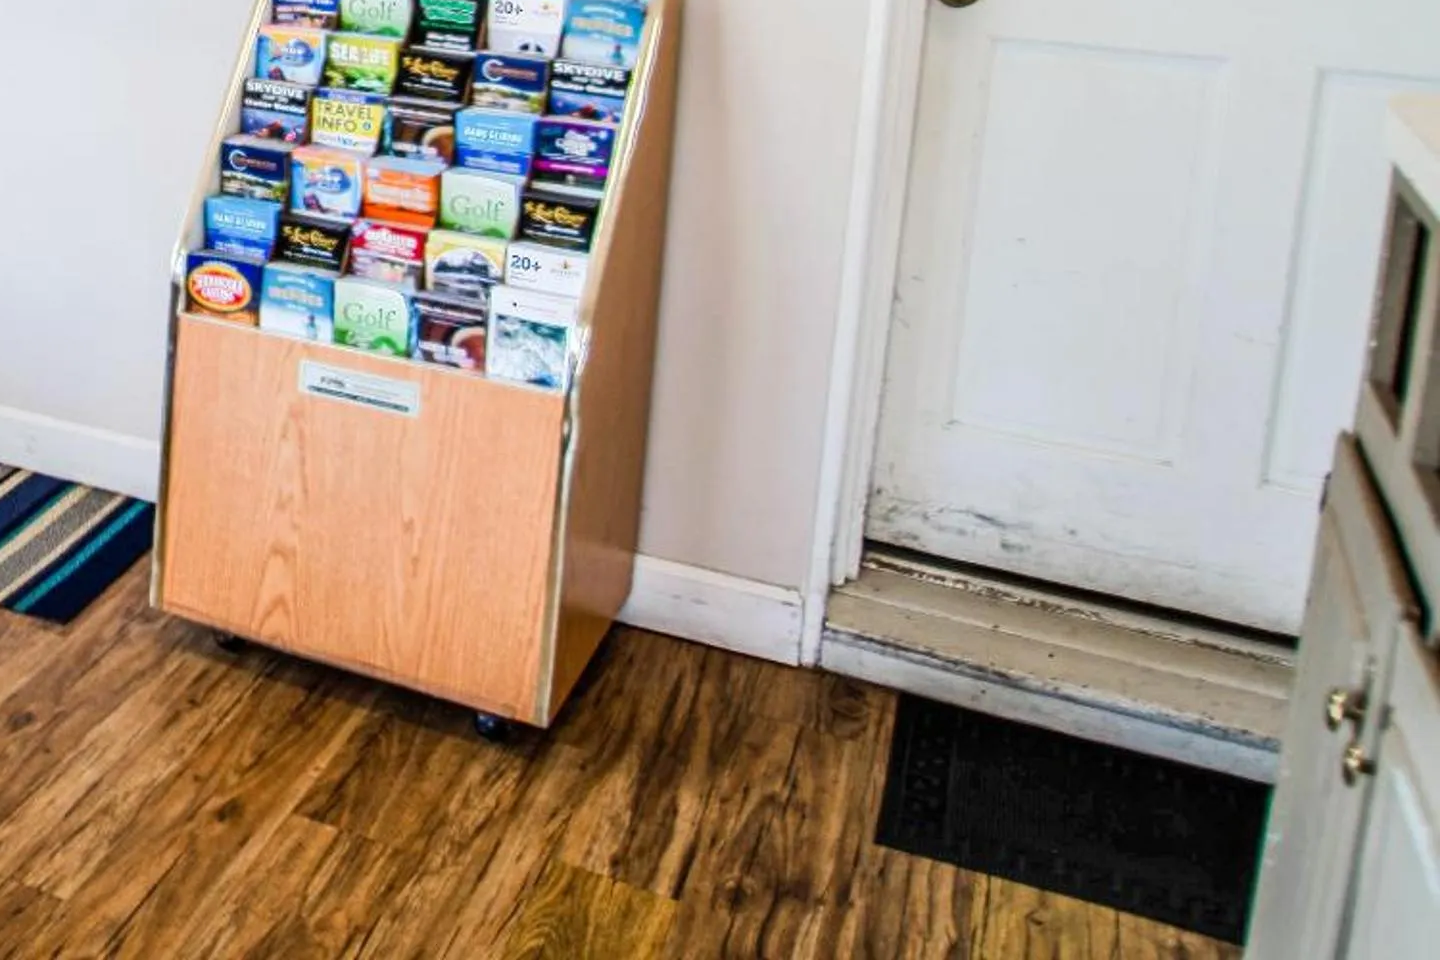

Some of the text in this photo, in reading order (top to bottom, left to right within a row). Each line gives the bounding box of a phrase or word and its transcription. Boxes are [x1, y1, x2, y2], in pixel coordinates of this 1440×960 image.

[494, 0, 524, 16] 20+
[553, 62, 625, 81] SKYDIVE
[246, 81, 304, 99] SKYDIVE
[316, 100, 372, 120] TRAVEL
[317, 116, 358, 133] INFO
[449, 195, 505, 222] Golf
[511, 255, 542, 271] 20+
[342, 302, 397, 330] Golf
